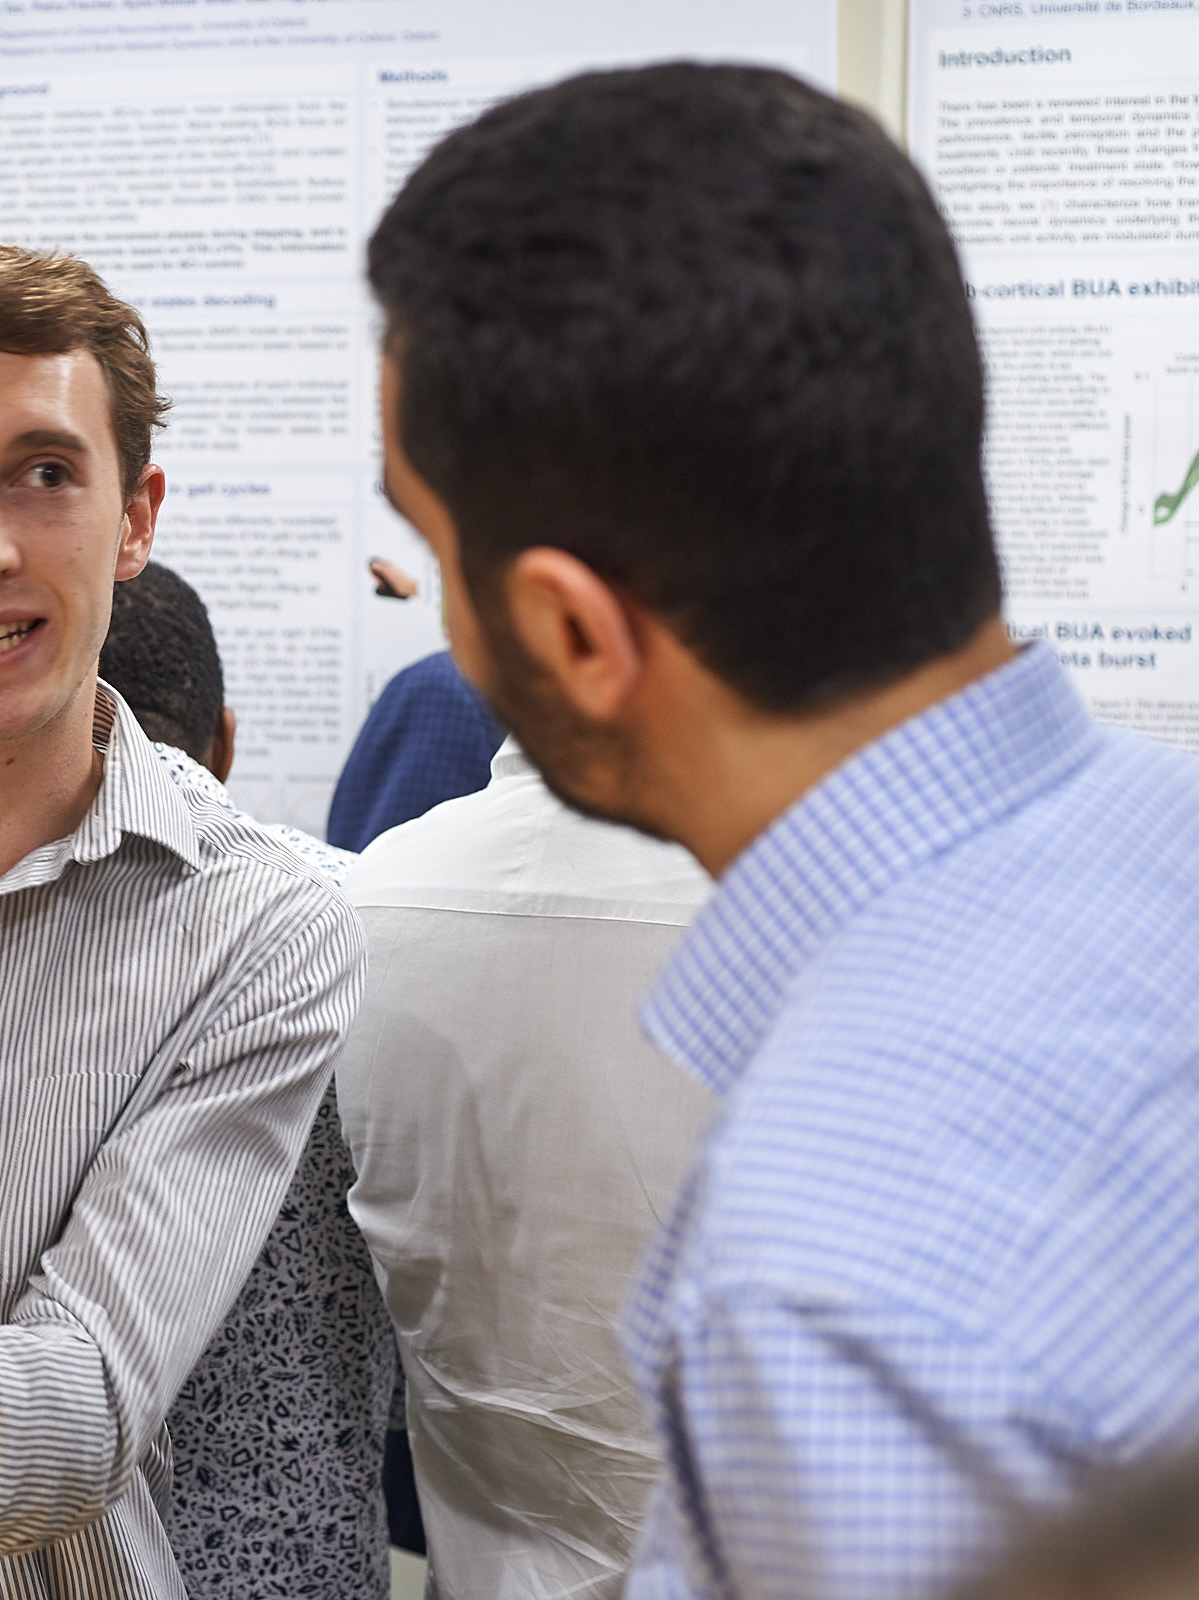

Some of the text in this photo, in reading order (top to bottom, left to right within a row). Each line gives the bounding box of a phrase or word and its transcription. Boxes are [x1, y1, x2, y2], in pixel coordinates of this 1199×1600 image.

[938, 48, 1071, 69] Introduction
[1072, 280, 1120, 298] BUA
[1127, 280, 1199, 297] exhibi
[1056, 623, 1103, 641] BUA
[1111, 624, 1192, 642] evoked
[1098, 650, 1156, 669] burst
